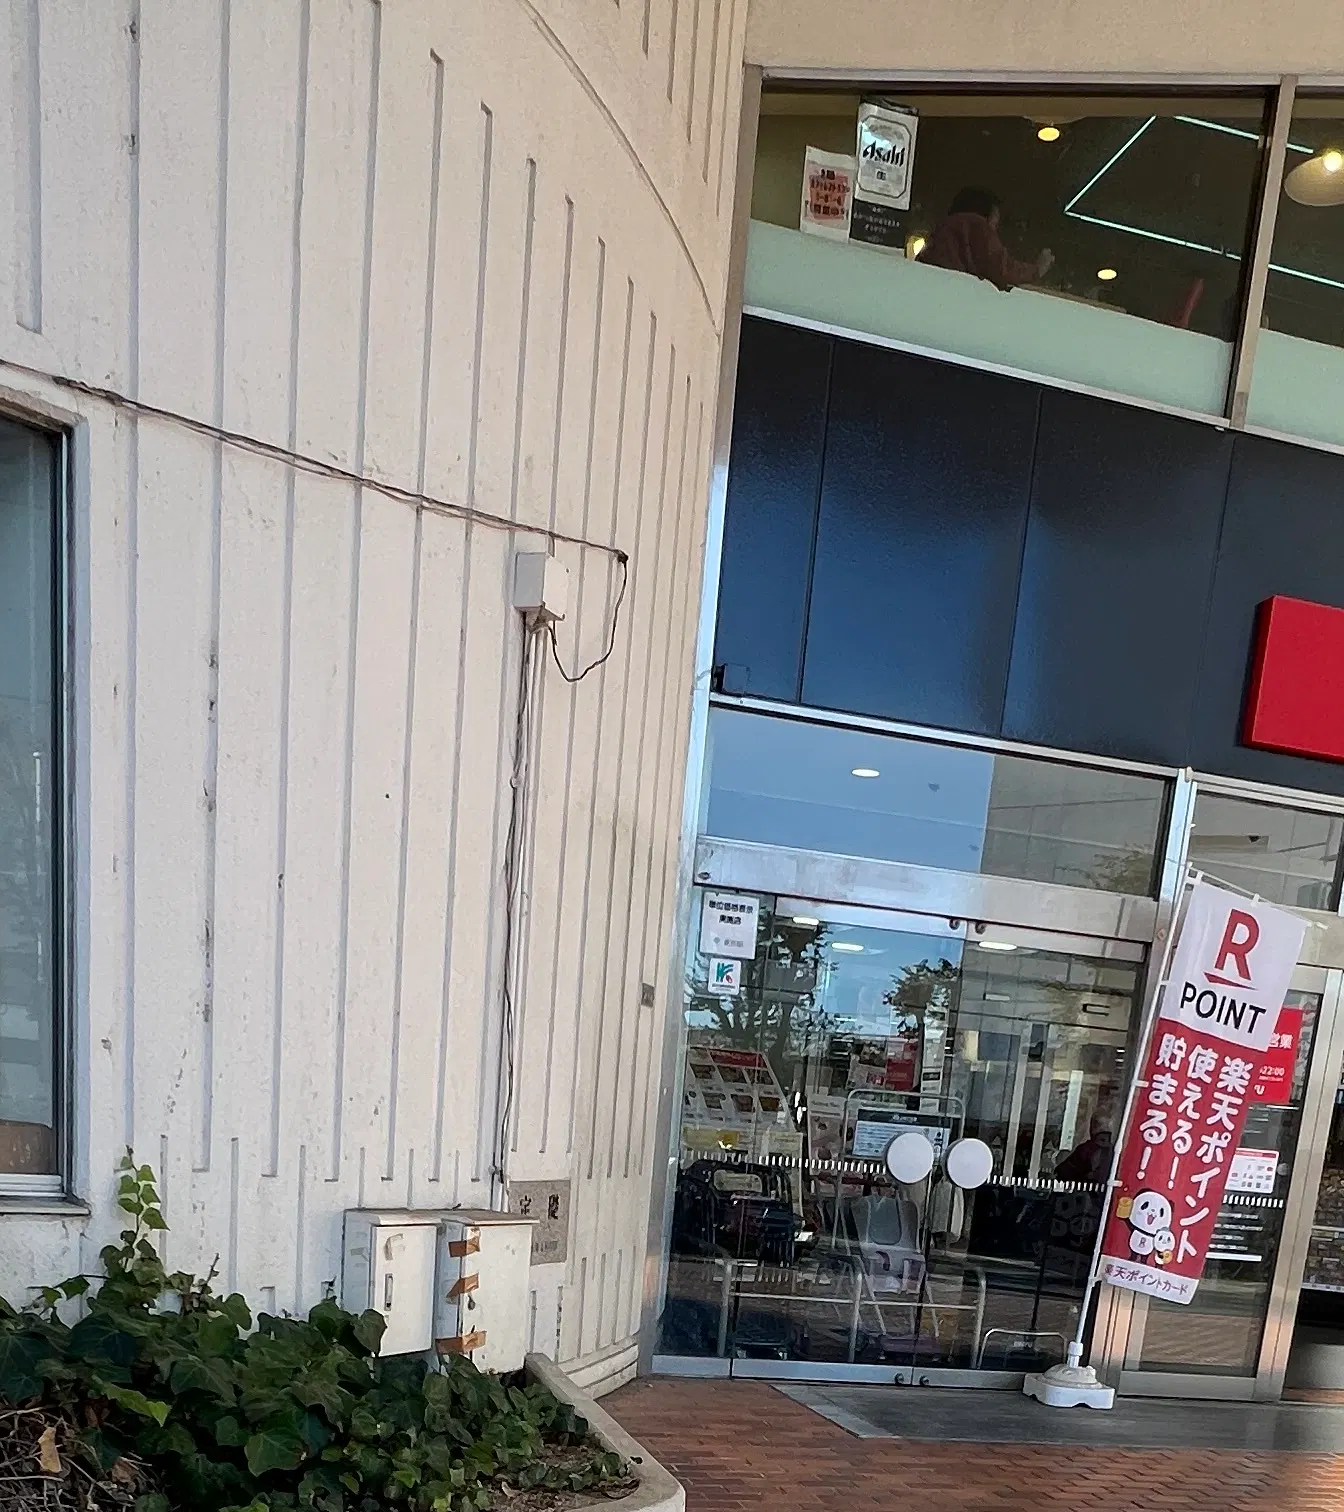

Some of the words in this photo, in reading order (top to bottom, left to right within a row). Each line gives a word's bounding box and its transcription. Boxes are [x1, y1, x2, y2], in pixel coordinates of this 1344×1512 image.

[862, 140, 906, 167] Asahi
[1214, 908, 1260, 981] R
[1179, 981, 1267, 1034] POINT
[1176, 1055, 1254, 1264] 楽天ポイント
[1103, 1262, 1190, 1296] 楽天ポイントカード
